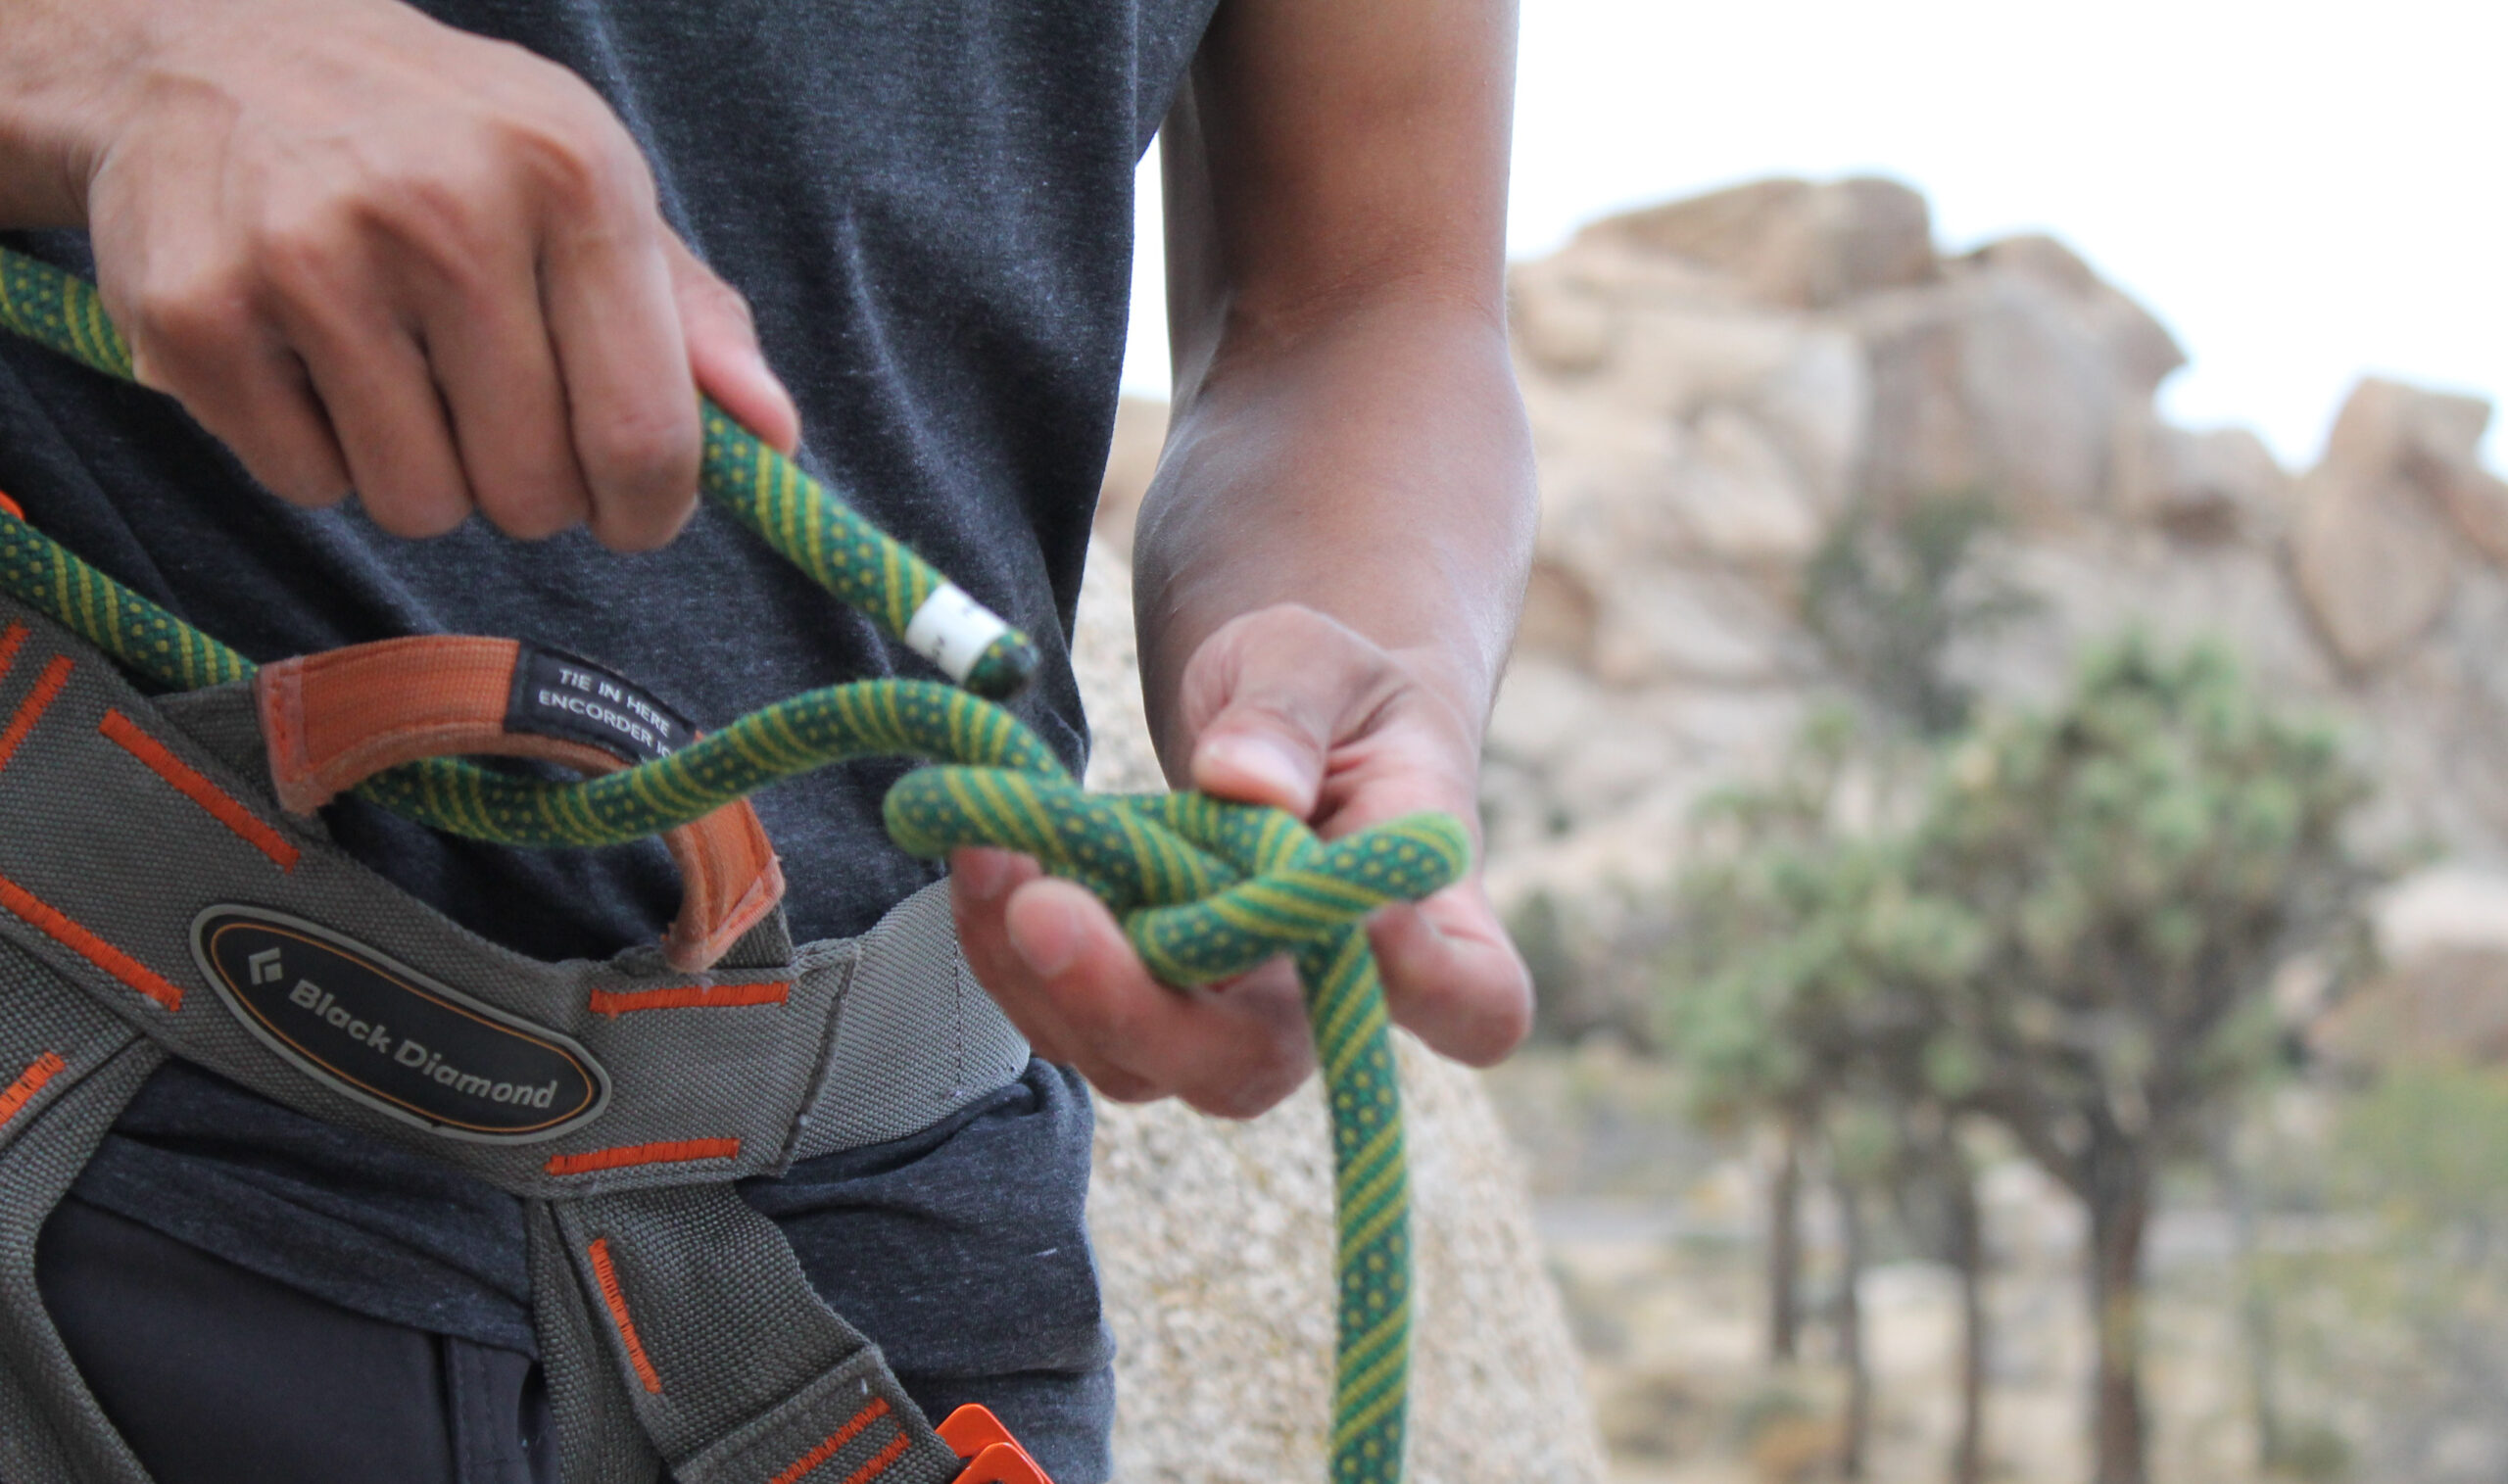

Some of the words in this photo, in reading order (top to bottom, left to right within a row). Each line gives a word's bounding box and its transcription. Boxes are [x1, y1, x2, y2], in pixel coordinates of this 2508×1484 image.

[539, 689, 653, 747] ENCORDER
[655, 740, 673, 759] IC
[558, 668, 592, 692] TIE
[598, 681, 622, 703] IN
[626, 694, 671, 738] HERE
[289, 979, 390, 1054] Black
[394, 1038, 558, 1109] Diamond
